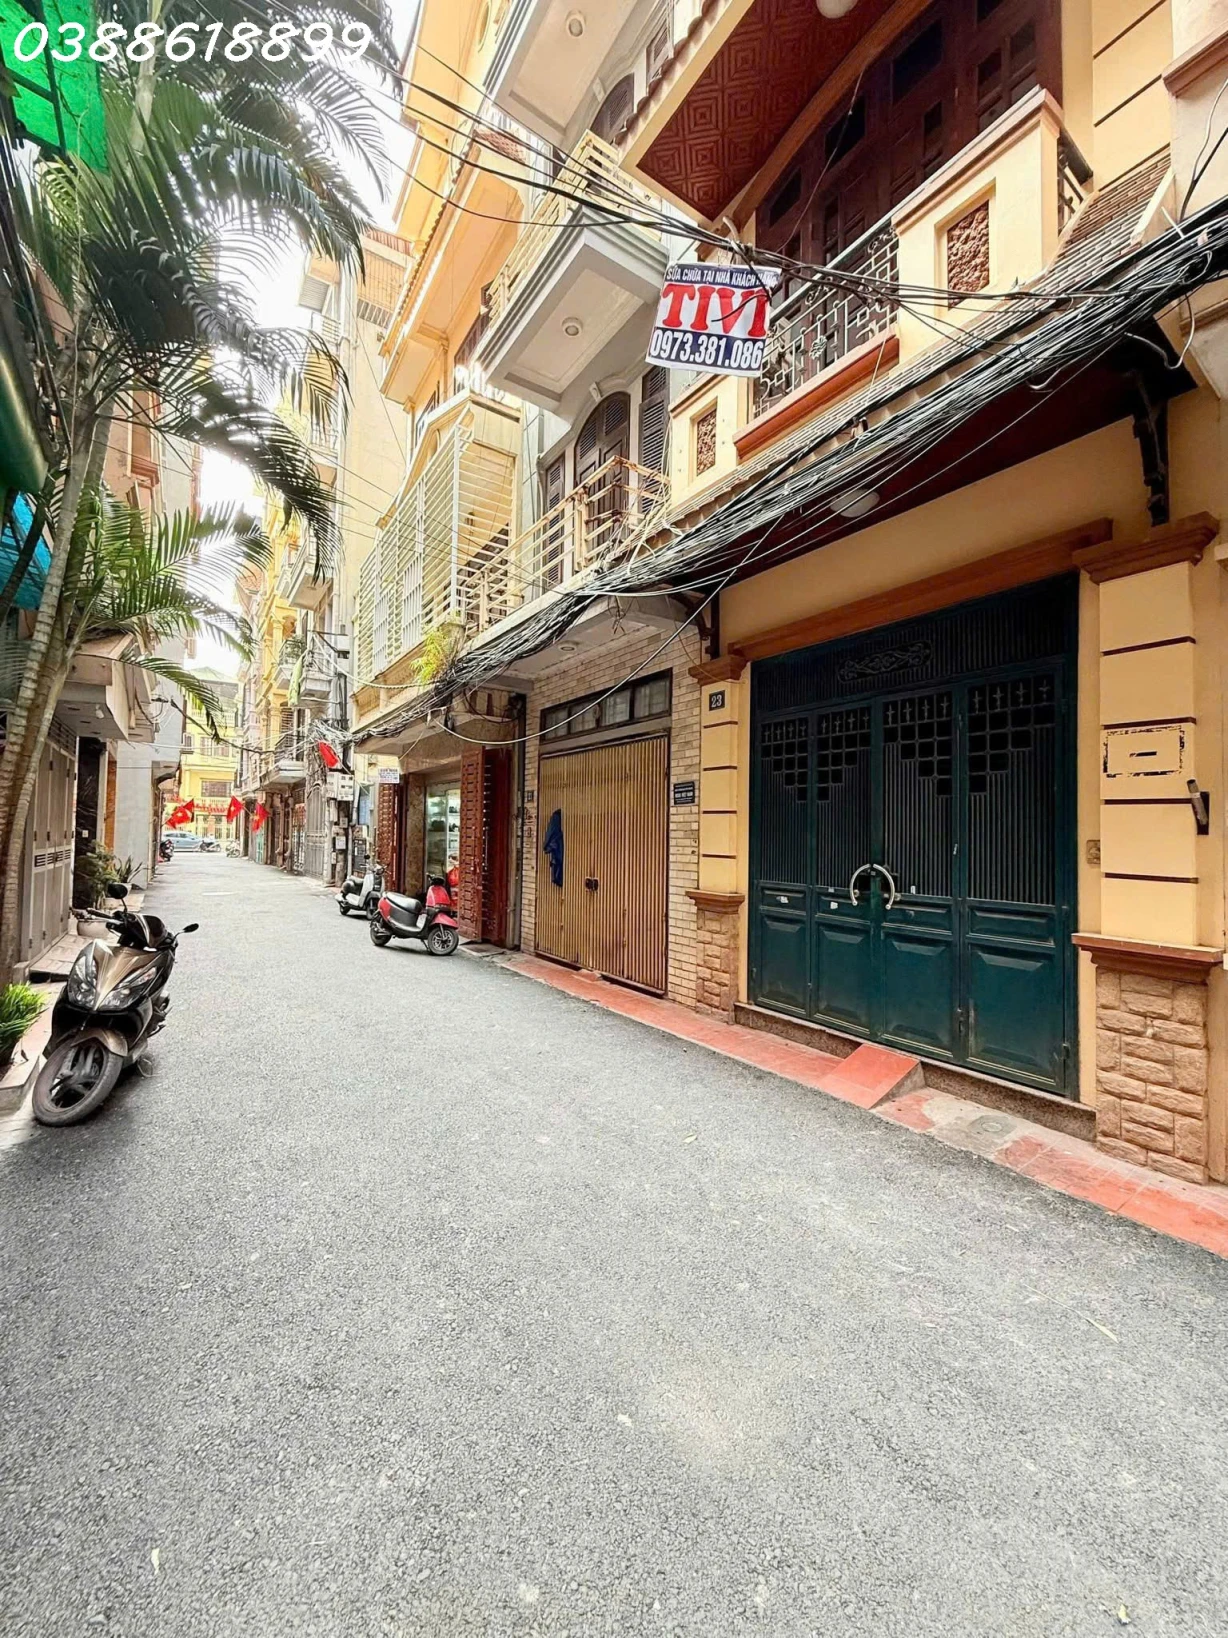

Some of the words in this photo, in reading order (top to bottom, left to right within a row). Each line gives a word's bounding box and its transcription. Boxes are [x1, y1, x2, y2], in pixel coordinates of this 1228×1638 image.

[682, 267, 702, 282] CHỮA
[703, 270, 715, 284] TẠI
[731, 271, 756, 287] KHÁCH
[662, 283, 767, 337] TIVI
[650, 329, 764, 369] 0973.381.086
[711, 694, 722, 708] 23
